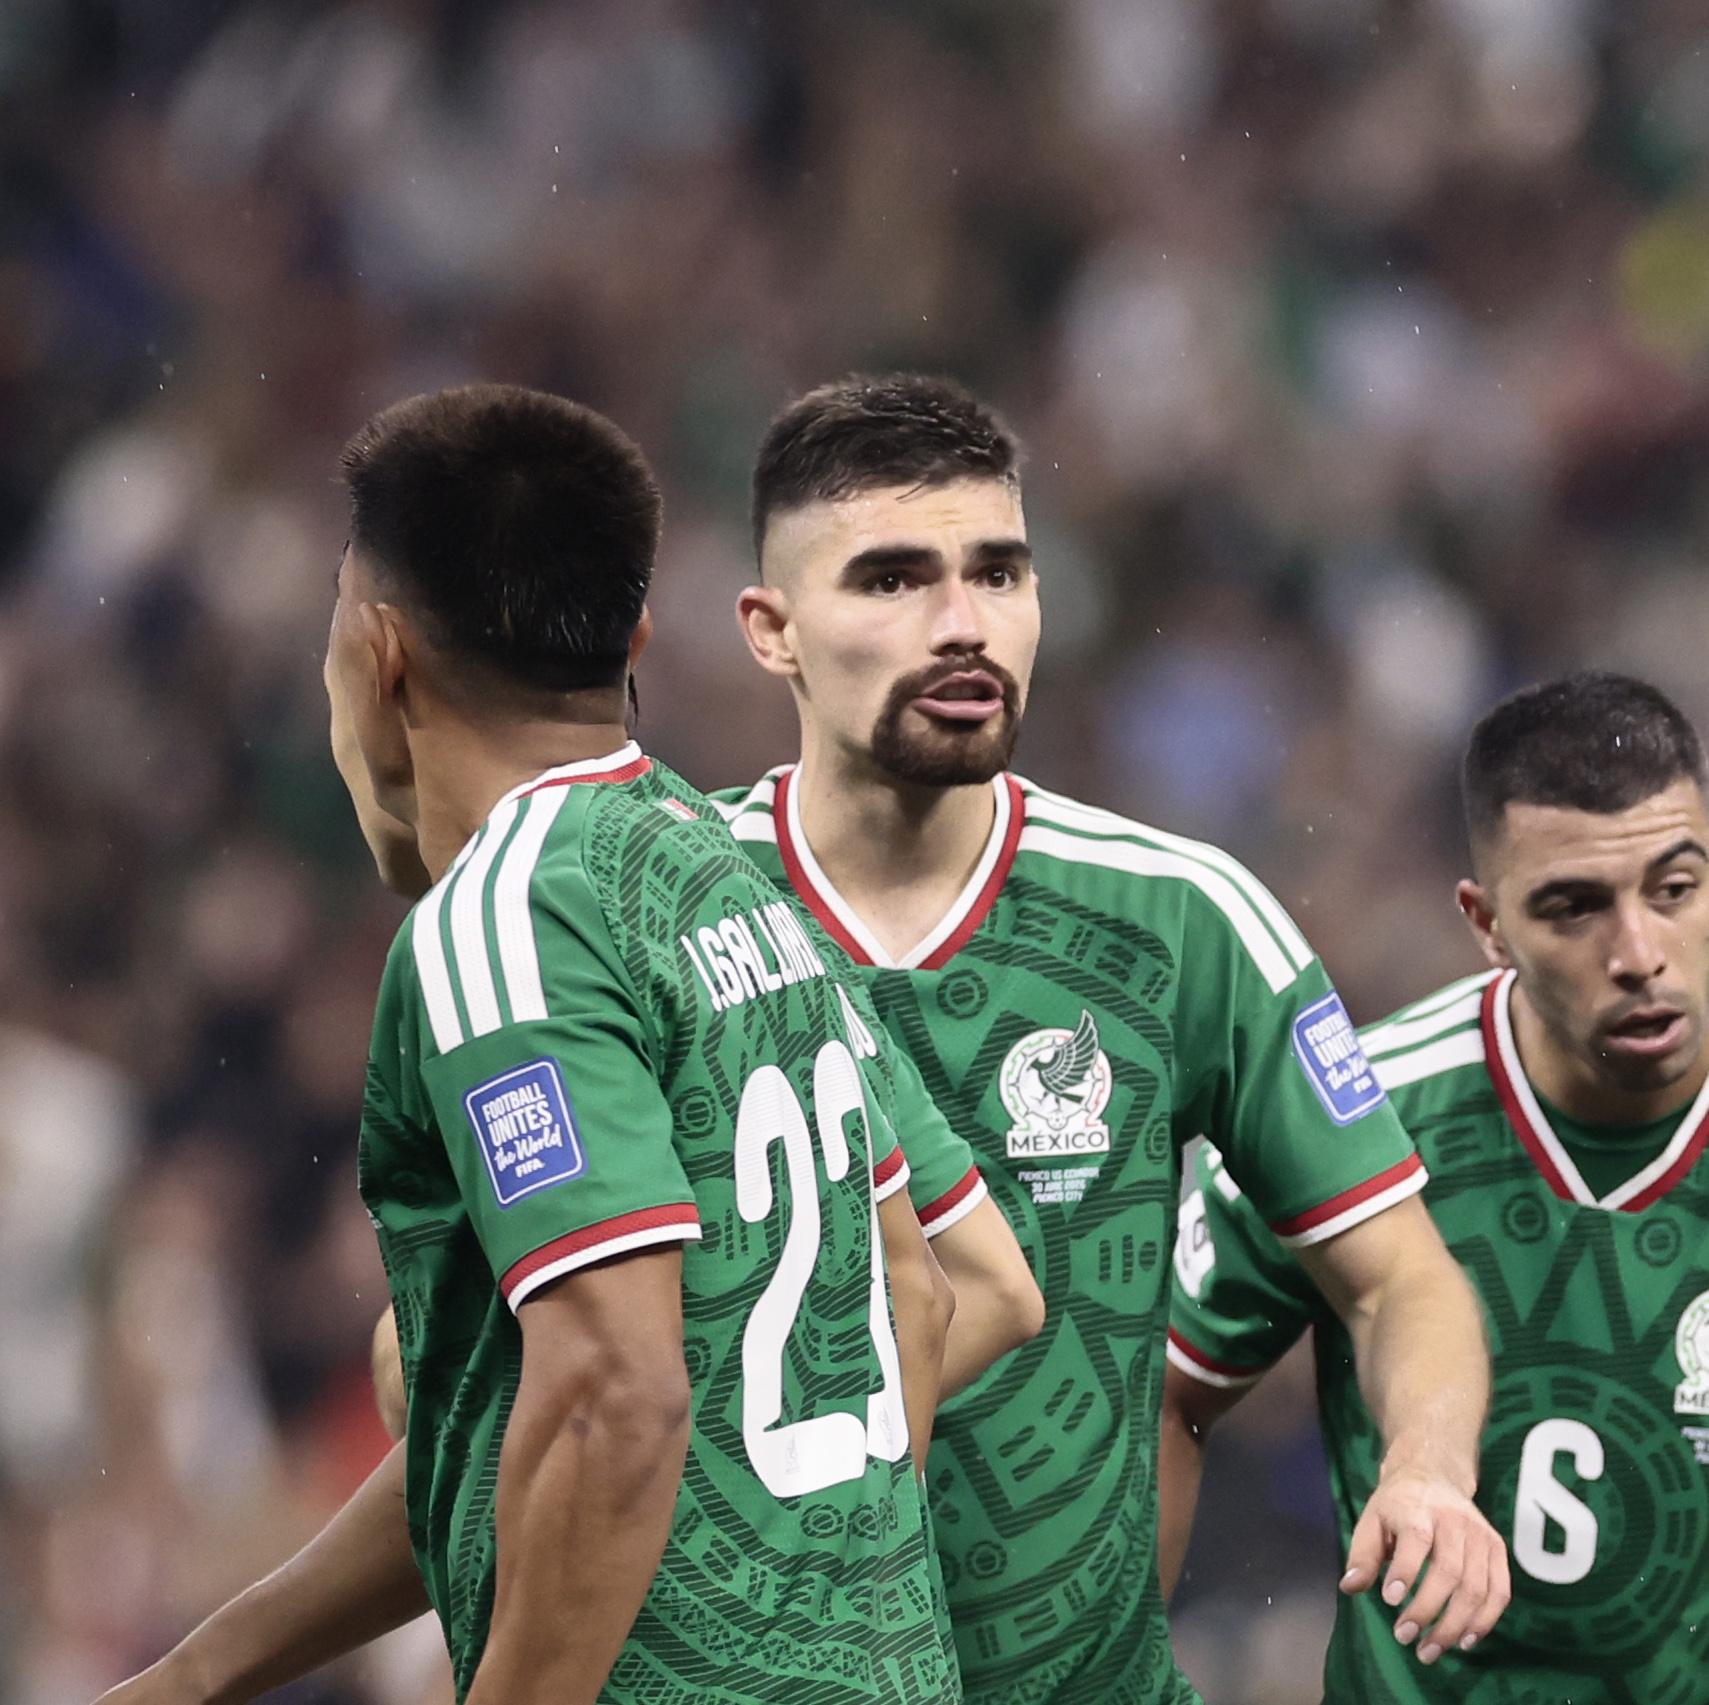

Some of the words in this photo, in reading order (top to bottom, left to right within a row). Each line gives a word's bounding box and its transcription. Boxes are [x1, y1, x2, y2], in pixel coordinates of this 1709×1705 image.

[481, 1082, 547, 1122] FOOTBALL
[488, 1100, 553, 1146] UNITES
[494, 1146, 516, 1172] the
[513, 1123, 563, 1160] World
[1011, 1131, 1105, 1152] MÉXICO
[514, 1158, 546, 1178] FIFA
[1514, 1417, 1605, 1585] 6
